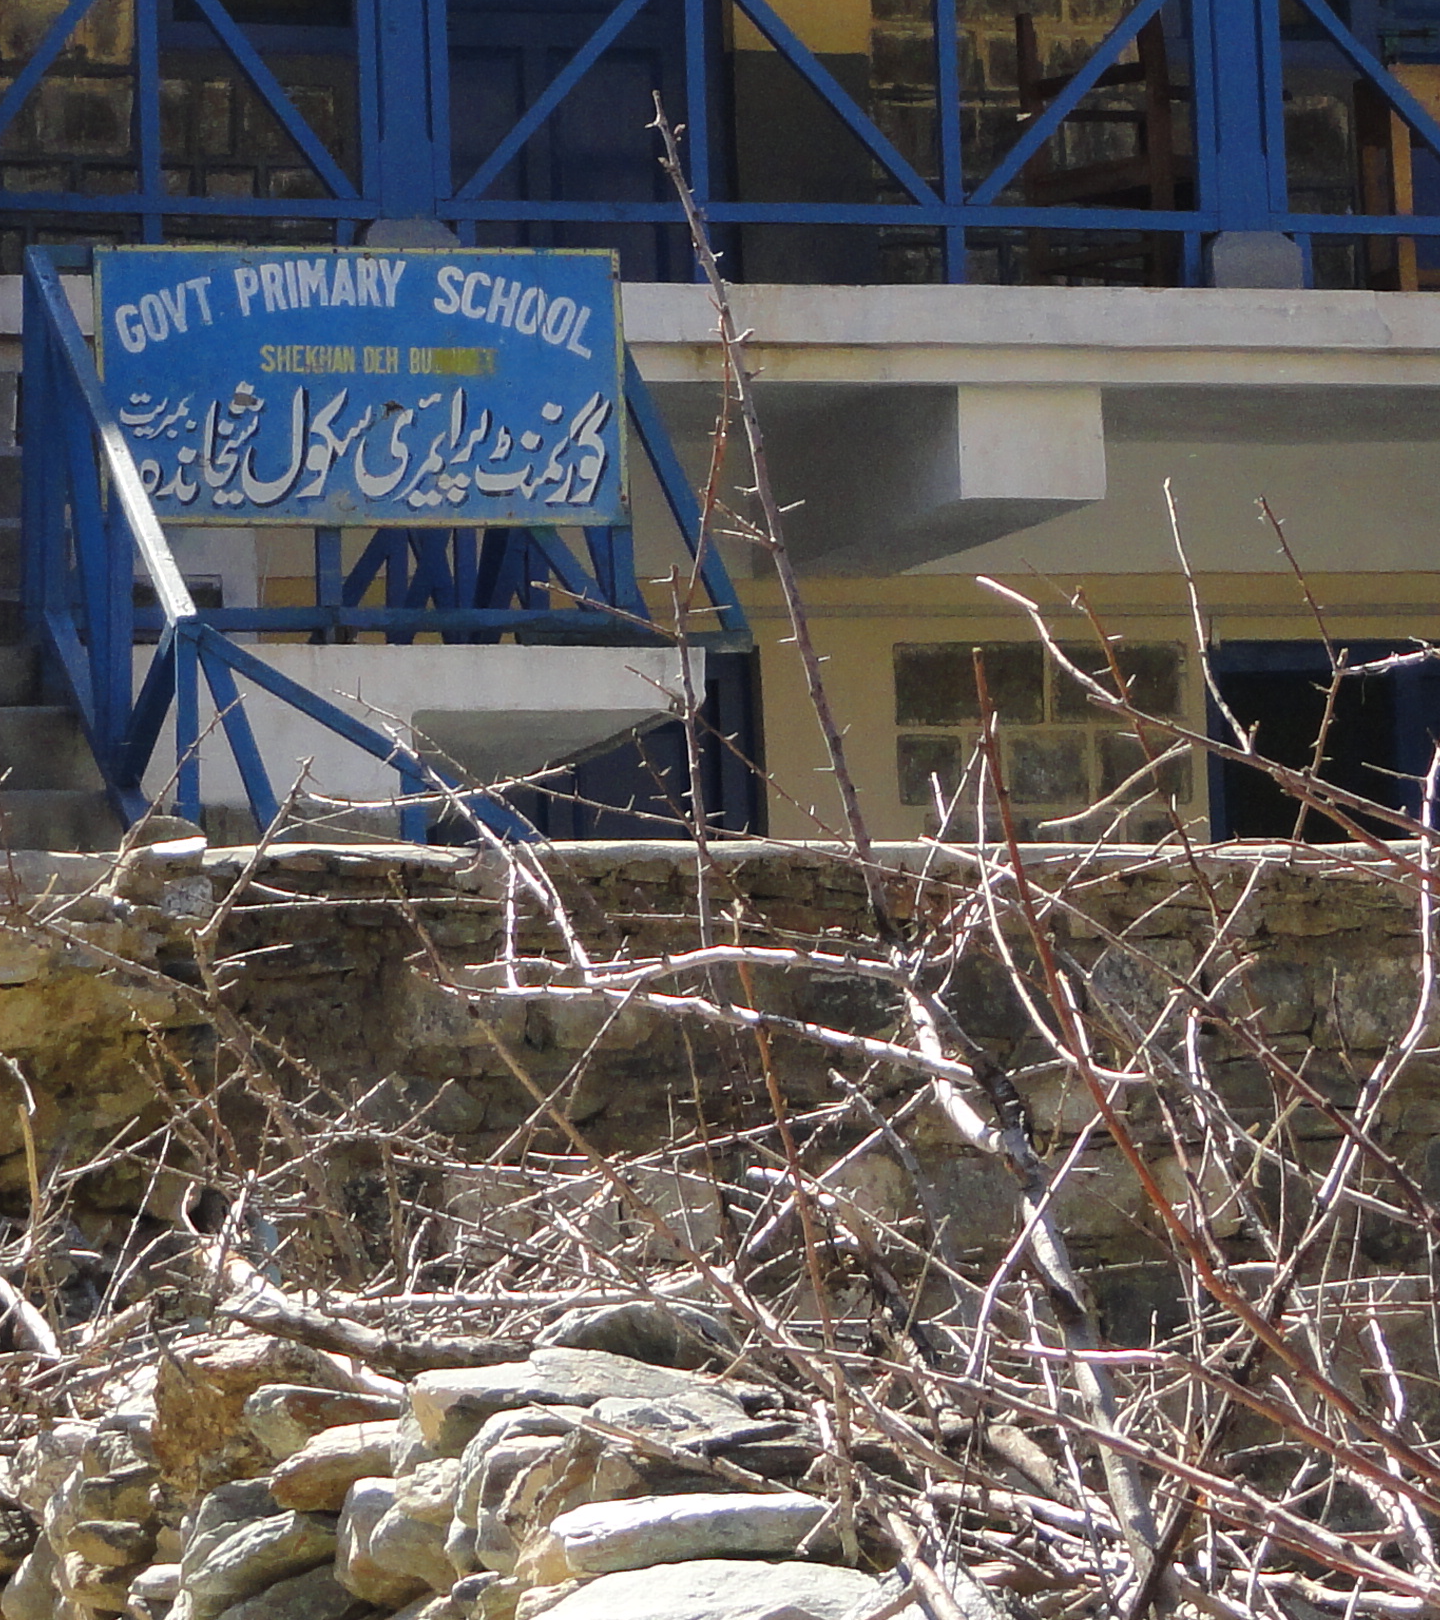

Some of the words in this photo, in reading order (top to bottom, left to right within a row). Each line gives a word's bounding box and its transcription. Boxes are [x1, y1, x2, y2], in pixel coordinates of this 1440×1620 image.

[114, 276, 214, 354] GOVT
[233, 258, 408, 317] PRIMARY
[433, 265, 594, 361] SCHOOL
[259, 344, 356, 375] SHEKHAN
[363, 346, 399, 375] DEH
[241, 384, 373, 504] سکول
[474, 390, 611, 504] گورنمنٹ
